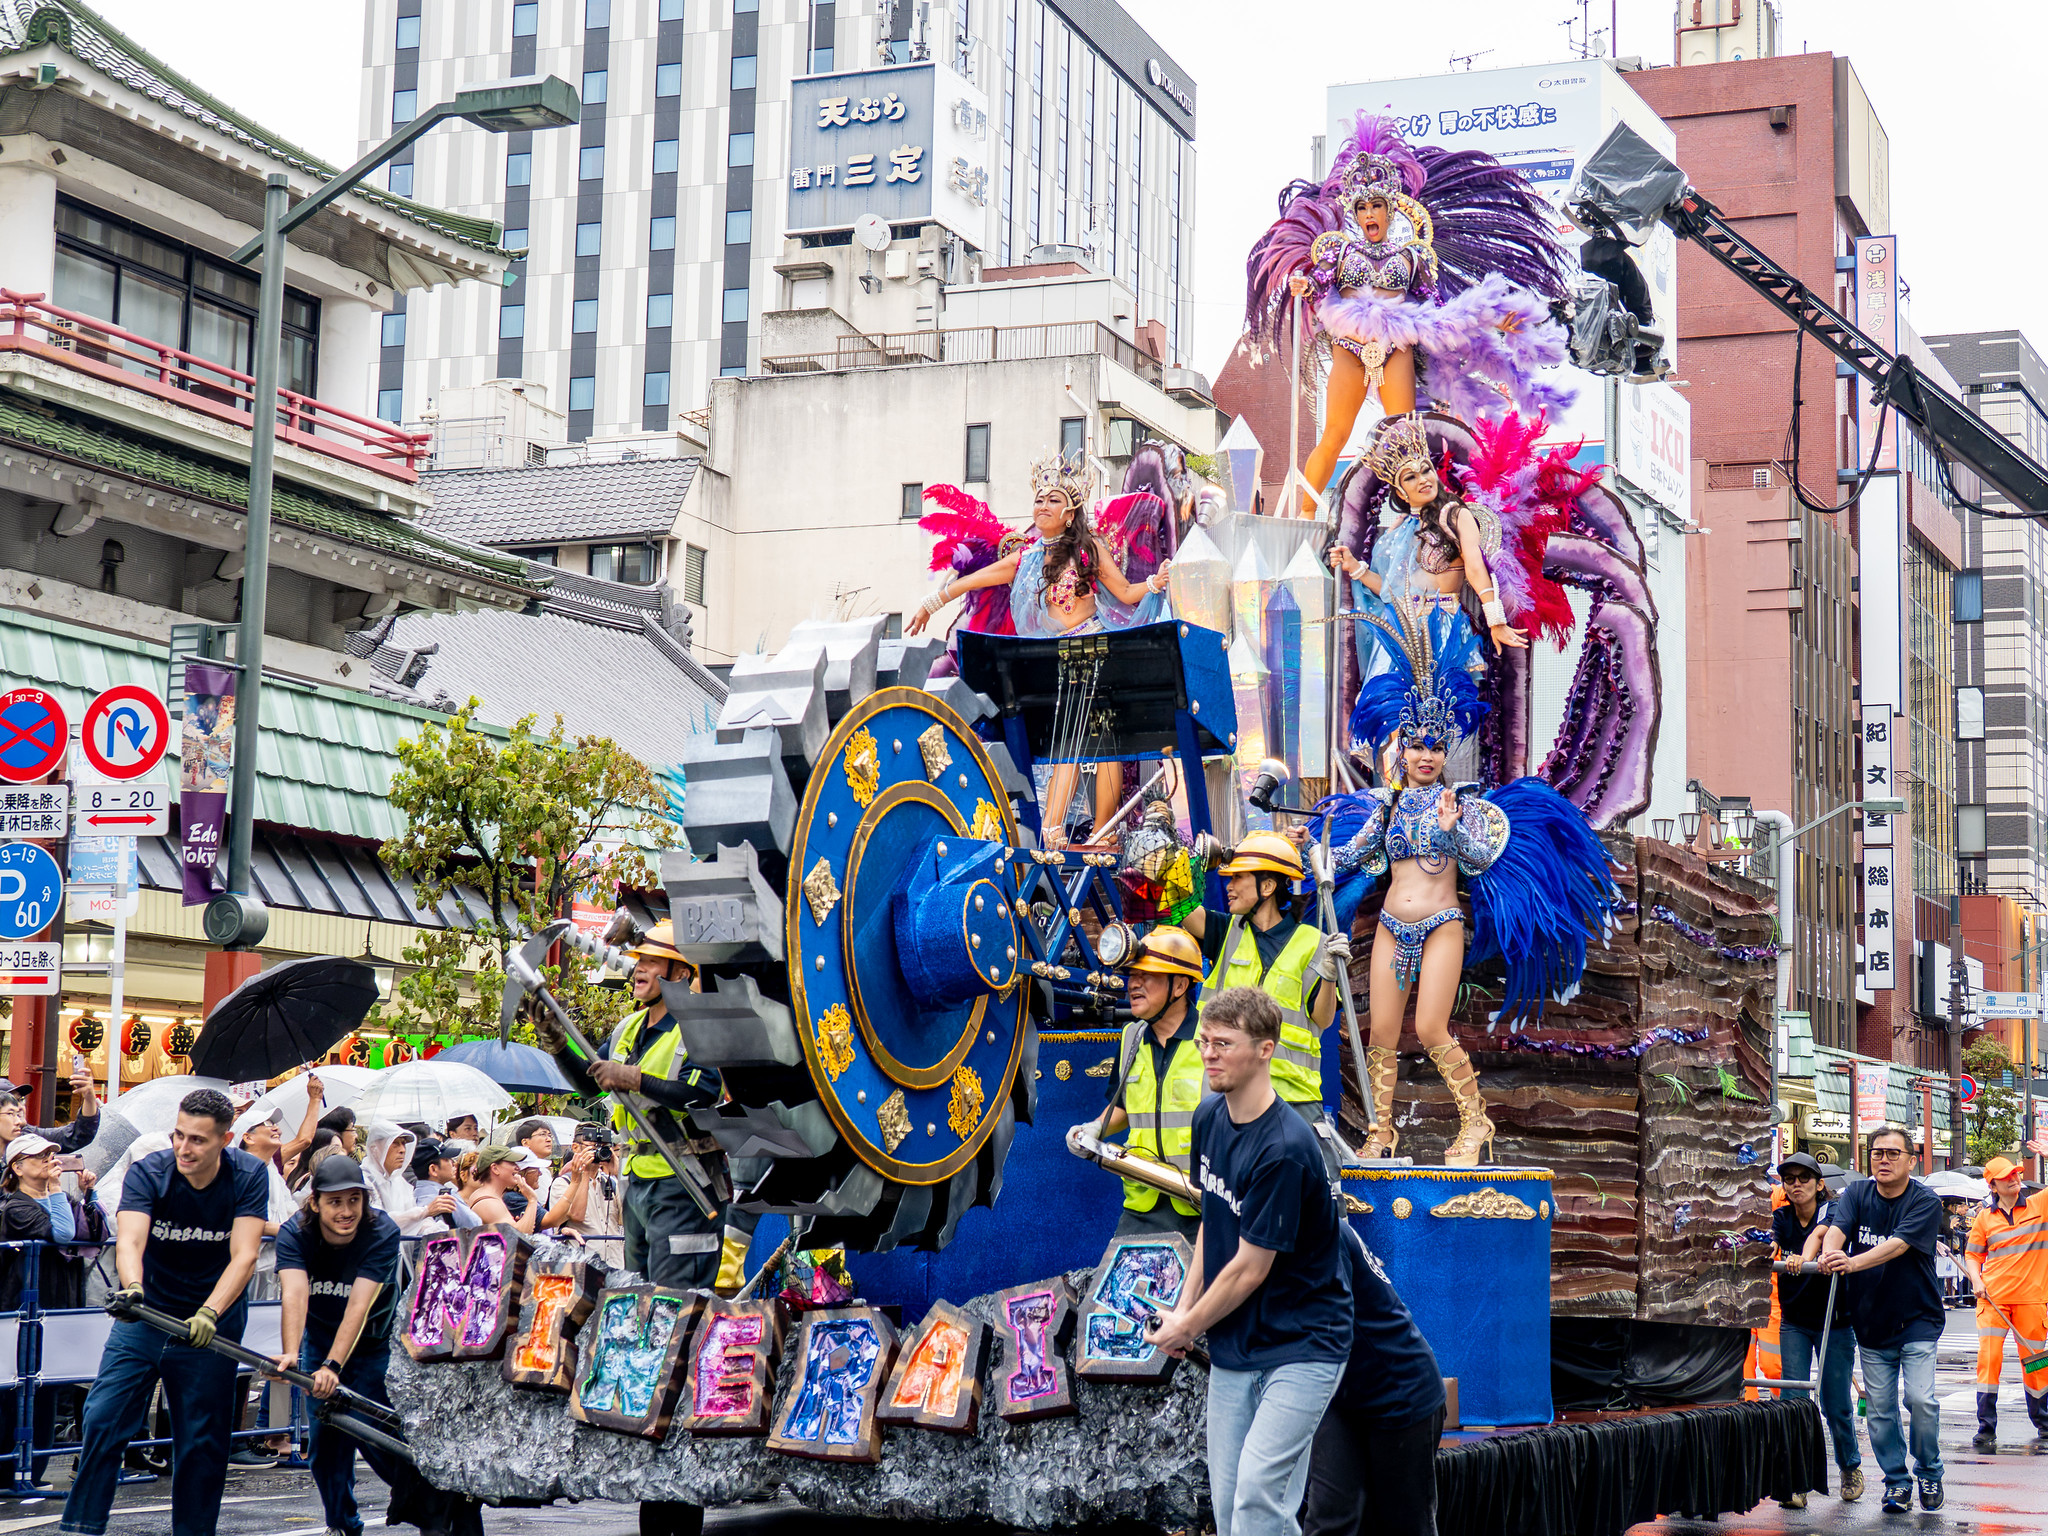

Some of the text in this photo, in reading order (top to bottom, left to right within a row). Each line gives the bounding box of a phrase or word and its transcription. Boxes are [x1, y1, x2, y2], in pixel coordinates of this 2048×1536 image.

[816, 92, 906, 128] 天ぷら
[1438, 103, 1557, 135] 胃の不快感に
[791, 144, 924, 190] 雷門 三定
[1650, 409, 1684, 476] IKO
[1650, 461, 1684, 499] 日本トムソン
[188, 822, 217, 843] Edo
[1865, 721, 1891, 972] 紀文堂 総本店
[2, 847, 37, 864] 9-19
[182, 845, 217, 868] Tokyo
[15, 901, 41, 928] 60
[411, 1232, 1186, 1446] MINERAIS
